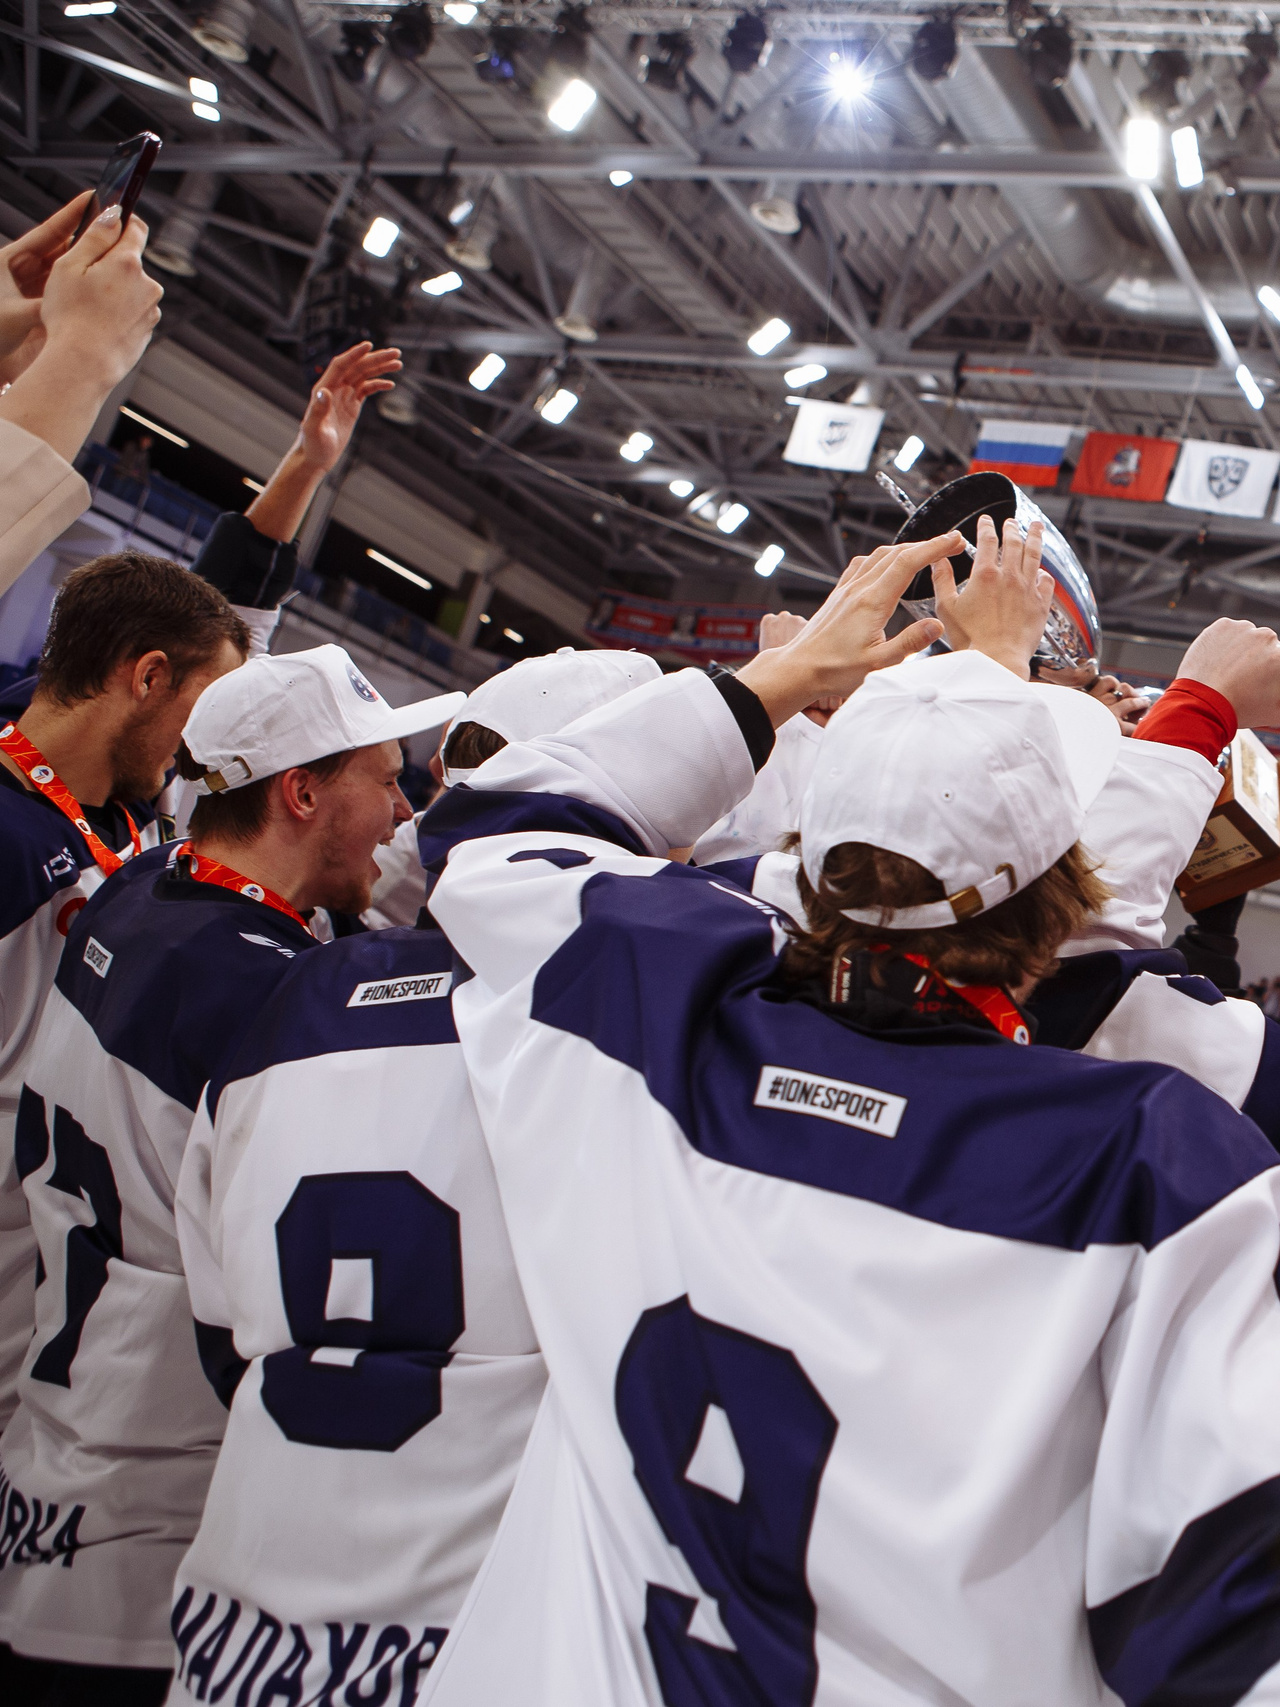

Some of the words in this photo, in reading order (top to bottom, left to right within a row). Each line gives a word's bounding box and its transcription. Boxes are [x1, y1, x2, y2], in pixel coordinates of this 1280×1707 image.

[768, 1075, 888, 1124] #IONESPORT
[260, 1170, 466, 1454] 8
[614, 1292, 840, 1707] 9
